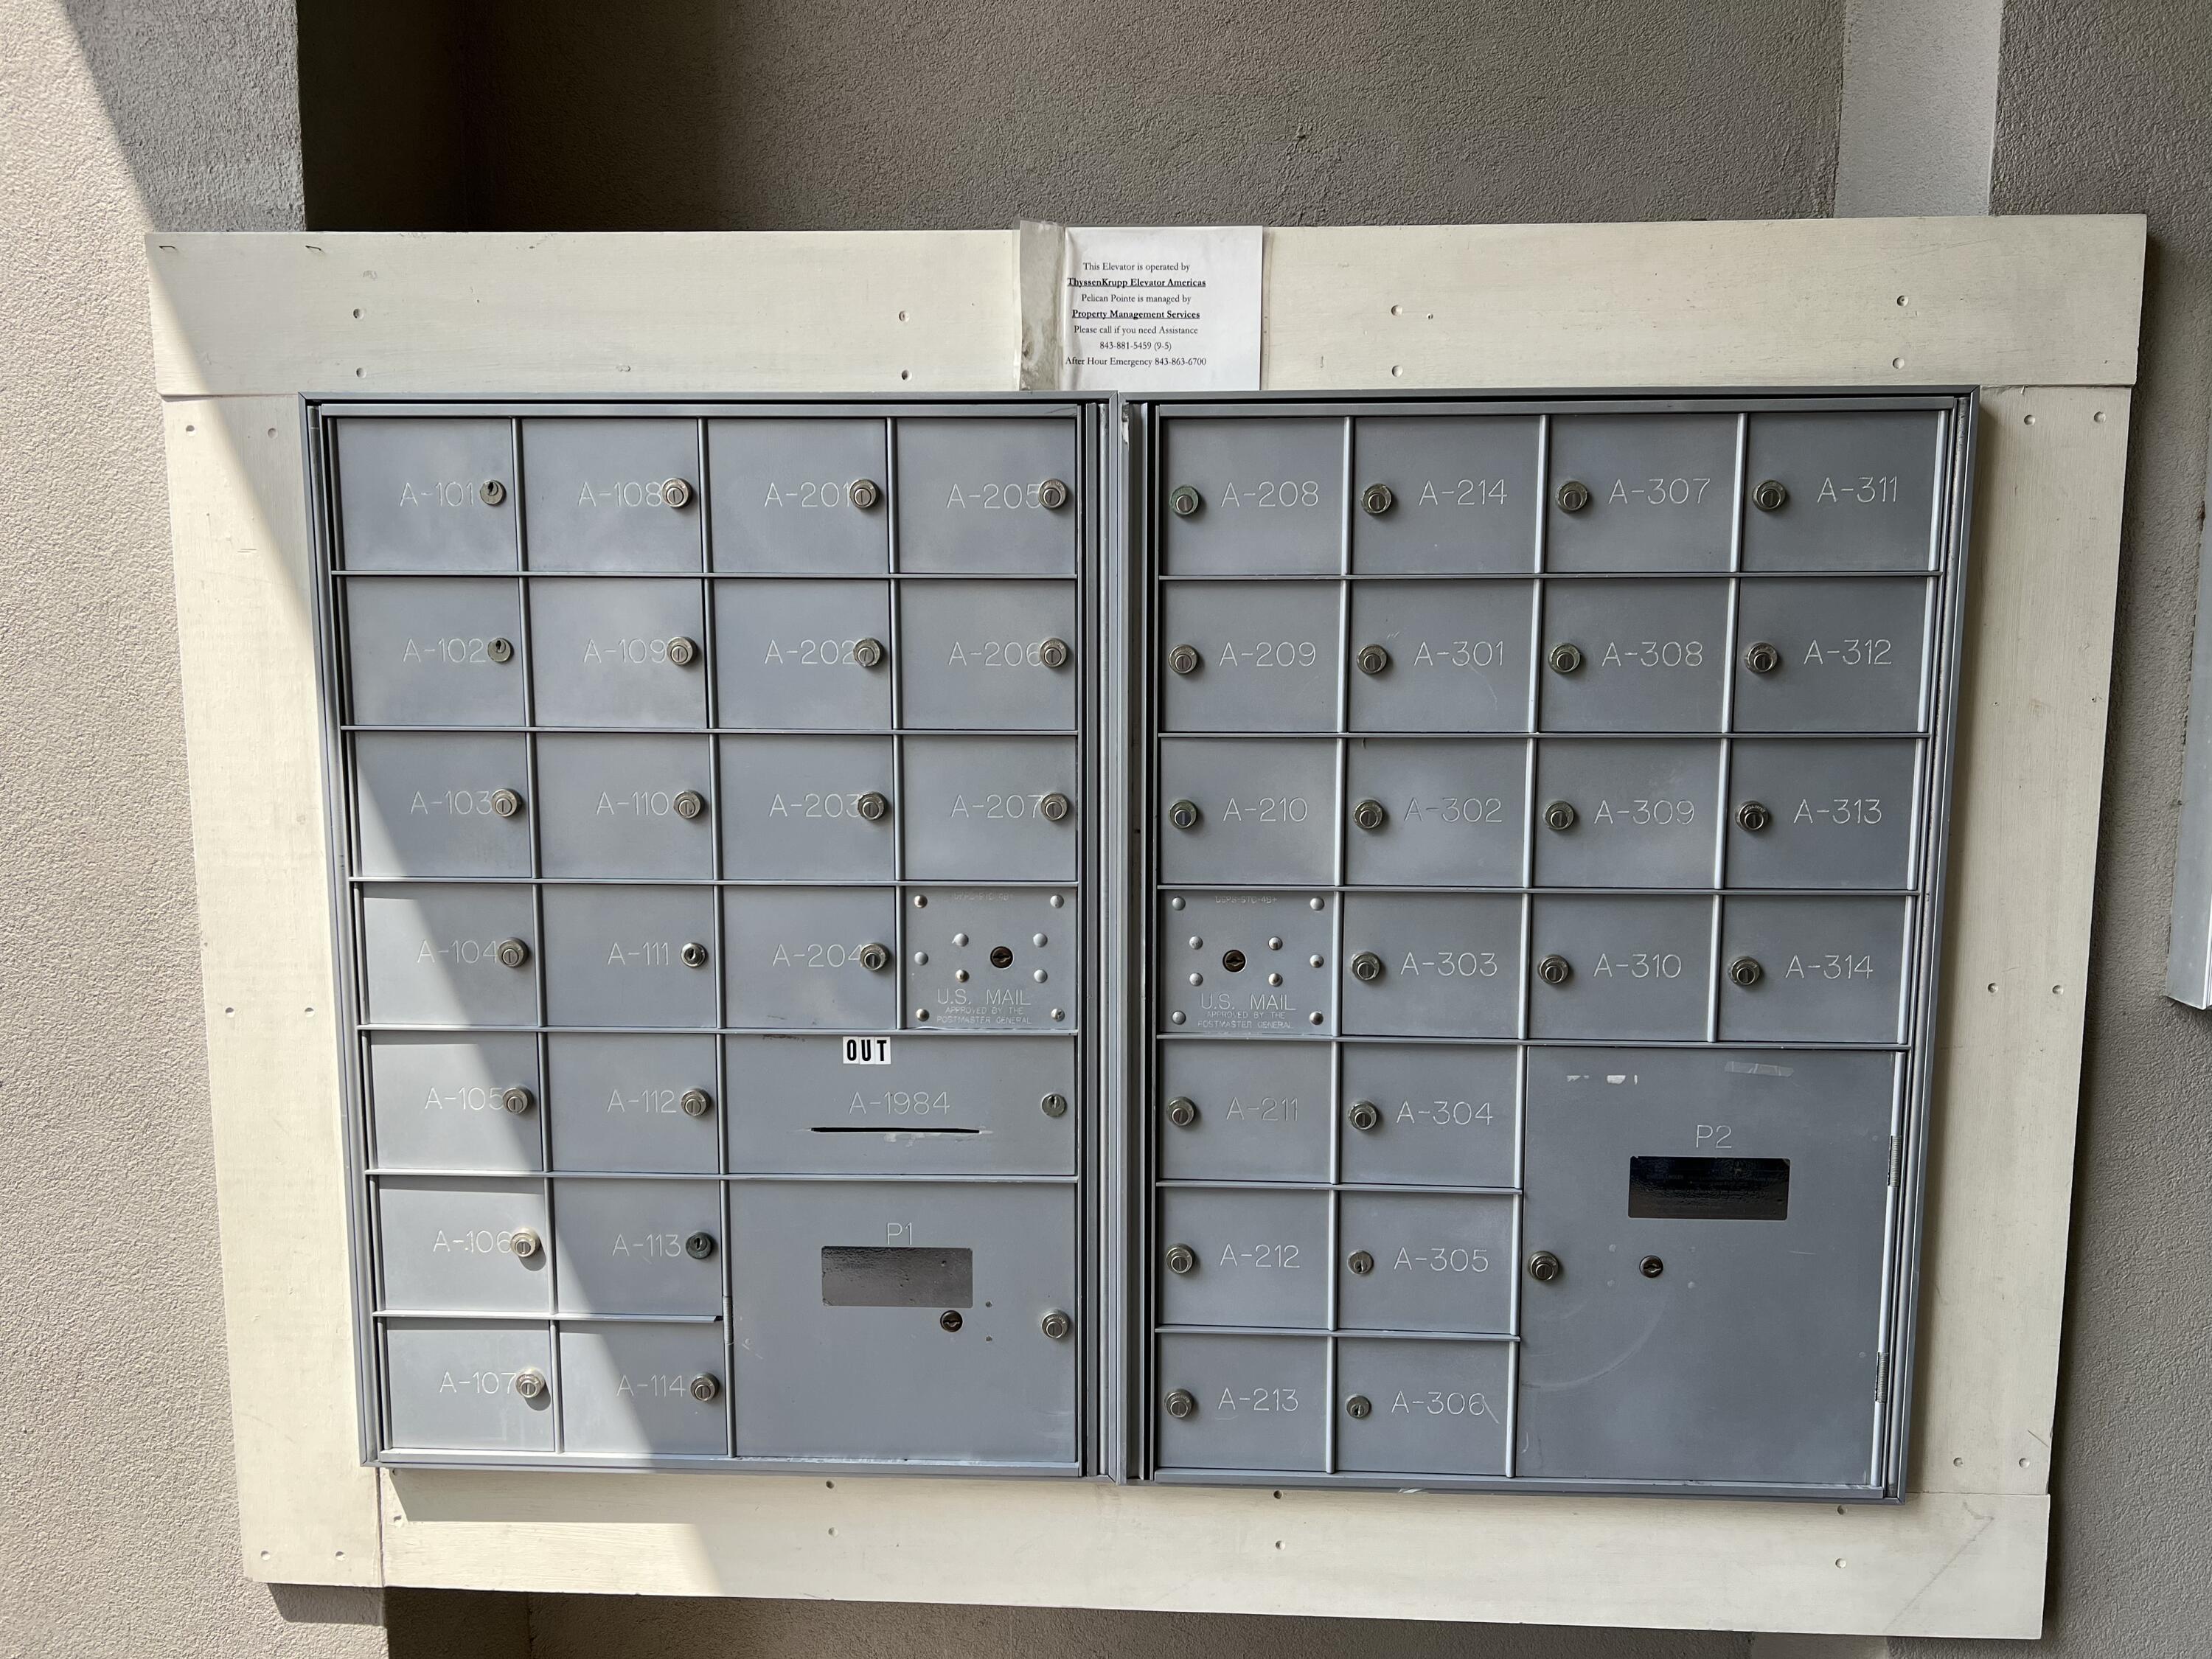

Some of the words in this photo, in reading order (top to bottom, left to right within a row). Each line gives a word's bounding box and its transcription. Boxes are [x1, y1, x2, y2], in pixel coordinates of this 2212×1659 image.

[1083, 262, 1100, 271] This
[1102, 262, 1135, 271] Elevator
[1137, 262, 1143, 271] is
[1145, 262, 1178, 273] operated
[1180, 262, 1190, 272] by
[1067, 277, 1128, 288] ThyssenKrupp
[1130, 277, 1166, 287] Elevator
[1167, 278, 1206, 287] Americas
[1081, 293, 1108, 302] Pelican
[1110, 294, 1135, 302] Pointe
[1138, 294, 1144, 302] is
[1146, 294, 1180, 305] managed
[1182, 294, 1192, 305] by
[1072, 310, 1107, 319] Property
[1110, 310, 1164, 320] Management
[1166, 310, 1200, 319] Services
[1074, 325, 1097, 334] Please
[1099, 325, 1112, 334] call
[1114, 325, 1120, 334] if
[1122, 327, 1136, 335] you
[1138, 326, 1156, 334] need
[1159, 326, 1198, 334] Assistance
[1099, 341, 1152, 350] 843-881-5459
[1154, 341, 1172, 352] (9-5)
[1065, 357, 1085, 366] After
[1087, 357, 1107, 366] Hour
[1110, 357, 1152, 368] Emergency
[1155, 357, 1207, 366] 843-863-6700
[400, 481, 475, 507] A-101
[578, 481, 664, 507] A-108
[764, 481, 851, 508] A-201
[946, 483, 1042, 509] A-205
[1220, 480, 1320, 508] A-208
[1419, 479, 1508, 506] A-214
[1608, 476, 1711, 505] A-307
[1817, 475, 1899, 504] A-311
[403, 638, 487, 664] A-102
[583, 639, 667, 664] A-109
[764, 639, 855, 665] A-202
[948, 641, 1043, 667] A-206
[1218, 641, 1317, 667] A-209
[1413, 640, 1504, 667] A-301
[1601, 640, 1704, 667] A-308
[1804, 638, 1893, 666] A-312
[410, 790, 494, 815] A-103
[596, 791, 669, 816] A-110
[769, 793, 860, 818] A-203
[950, 794, 1043, 818] A-207
[1222, 796, 1309, 823] A-210
[1403, 796, 1503, 824] A-302
[1593, 799, 1695, 826] A-309
[1793, 798, 1883, 825] A-313
[417, 940, 500, 964] A-104
[607, 942, 669, 967] A-111
[772, 944, 863, 968] A-204
[1400, 951, 1498, 978] A-303
[1593, 953, 1683, 979] A-310
[1784, 954, 1874, 980] A-314
[937, 988, 972, 1005] U.S.
[986, 989, 1032, 1006] MAIL
[1200, 992, 1235, 1010] U.S.
[1250, 993, 1297, 1011] MAIL
[936, 1015, 991, 1024] POSTMASTER
[996, 1016, 1033, 1025] GENERAL
[945, 1006, 987, 1015] APPROVED
[992, 1006, 1003, 1015] BY
[1008, 1006, 1024, 1015] THE
[1207, 1010, 1249, 1019] APPROVED
[1253, 1011, 1265, 1020] BY
[1270, 1011, 1286, 1020] THE
[1197, 1020, 1252, 1029] POSTMASTER
[1257, 1020, 1295, 1029] GENERAL
[846, 1039, 888, 1062] OUT
[425, 1087, 505, 1110] A-105
[607, 1089, 678, 1114] A-112
[849, 1091, 951, 1116] A-1984
[1226, 1096, 1298, 1122] A-211
[1396, 1101, 1494, 1126] A-304
[1695, 1124, 1733, 1150] P2
[433, 1230, 512, 1253] A-106
[612, 1234, 682, 1258] A-113
[886, 1222, 914, 1246] P1
[1220, 1243, 1301, 1269] A-212
[1394, 1247, 1489, 1273] A-305
[439, 1371, 517, 1395] A-107
[616, 1374, 687, 1398] A-114
[1217, 1387, 1299, 1413] A-213
[1391, 1391, 1486, 1416] A-306
